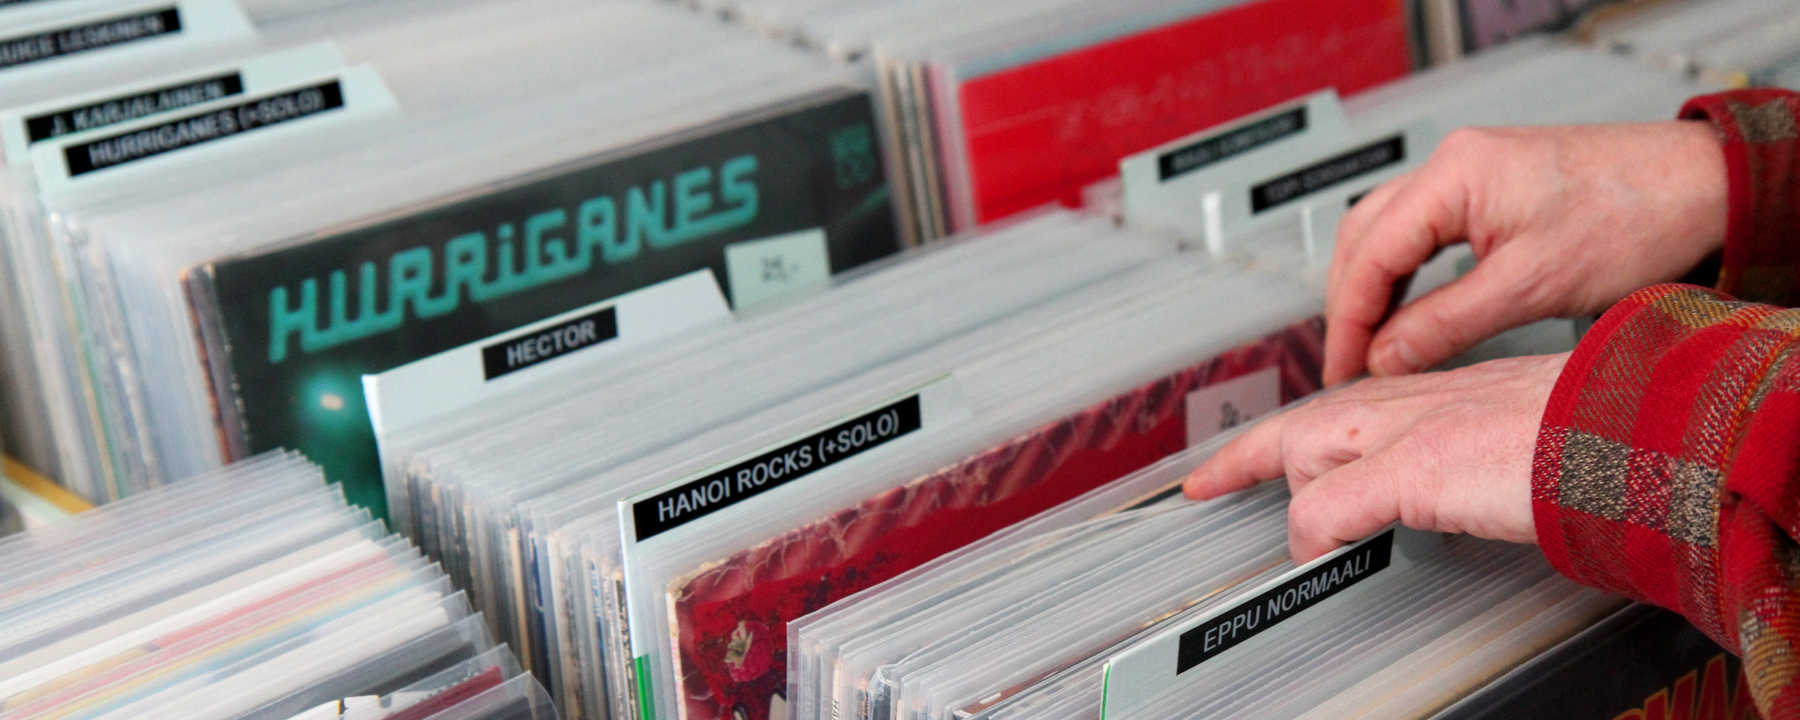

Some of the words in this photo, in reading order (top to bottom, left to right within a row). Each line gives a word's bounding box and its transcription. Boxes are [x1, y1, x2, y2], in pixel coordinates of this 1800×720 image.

[72, 81, 226, 130] KARJALAINEN
[88, 109, 237, 167] HURRIGANES
[238, 88, 325, 131] (+SOLO)
[506, 319, 597, 369] HECTOR
[657, 480, 731, 523] HANOI
[736, 445, 814, 494] ROCKS
[816, 409, 901, 464] (+SOLO)
[1203, 604, 1261, 653] EPPU
[1266, 549, 1373, 621] NORMAALI
